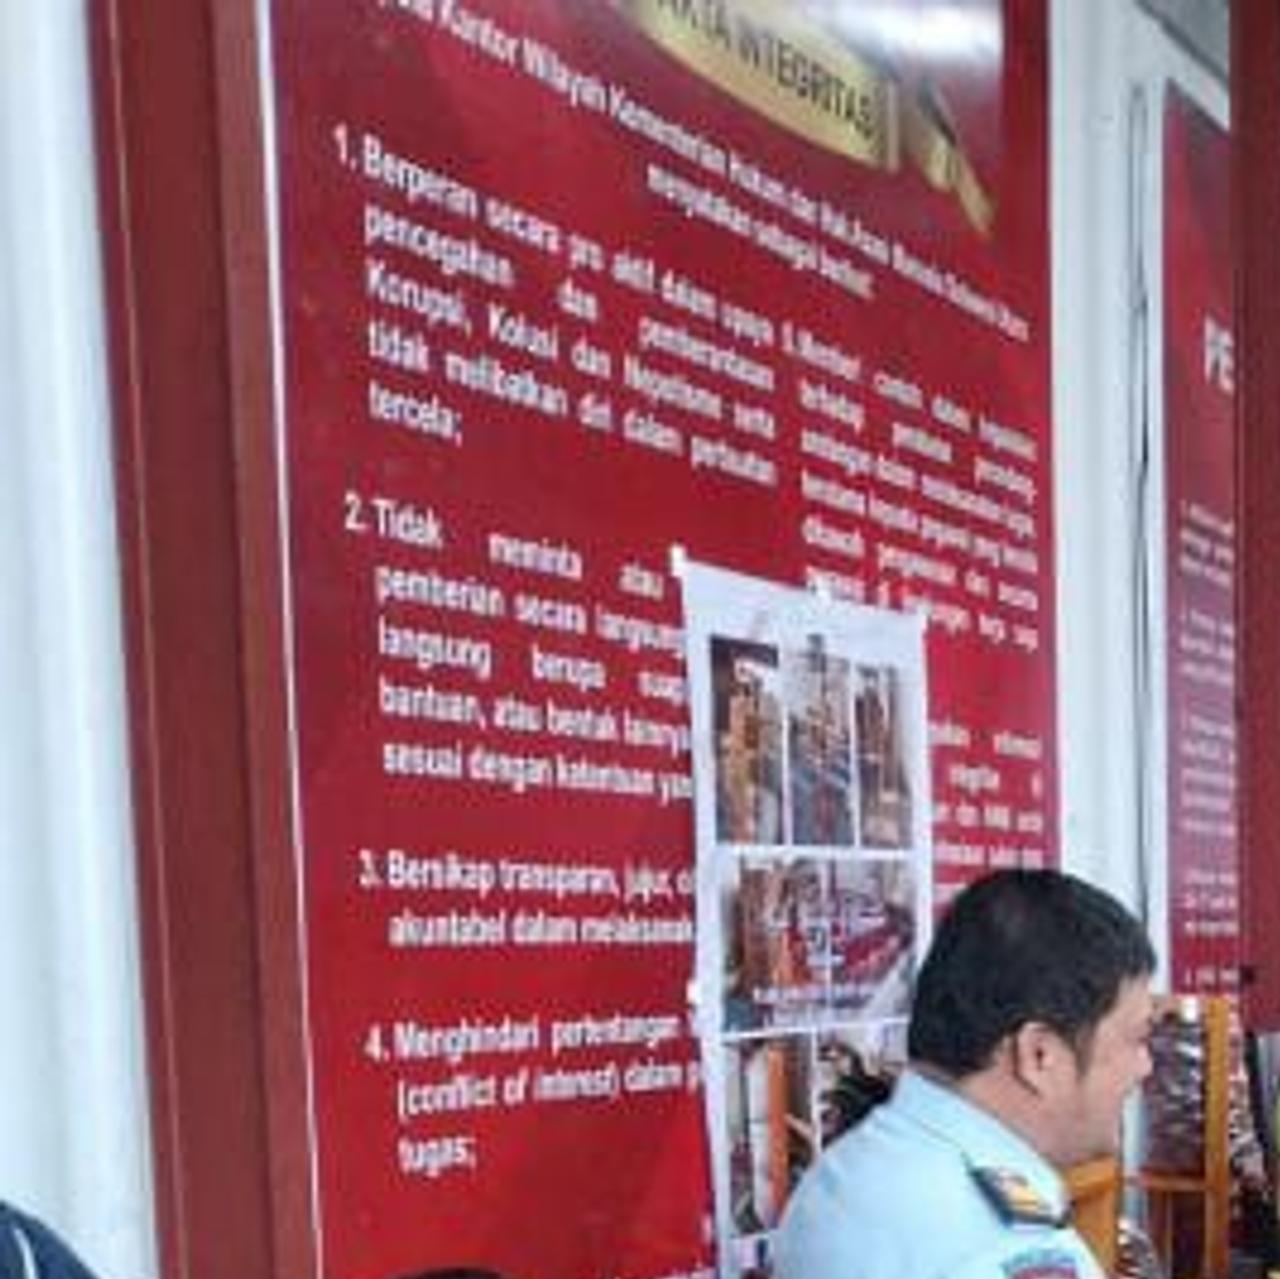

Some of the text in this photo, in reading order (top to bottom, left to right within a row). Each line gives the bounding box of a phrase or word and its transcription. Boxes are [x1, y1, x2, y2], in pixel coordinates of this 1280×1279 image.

[363, 132, 478, 221] Berperan
[364, 202, 516, 287] pencegahan
[371, 496, 443, 549] Tidak
[377, 614, 492, 681] langsung
[387, 846, 496, 900] Bersikap
